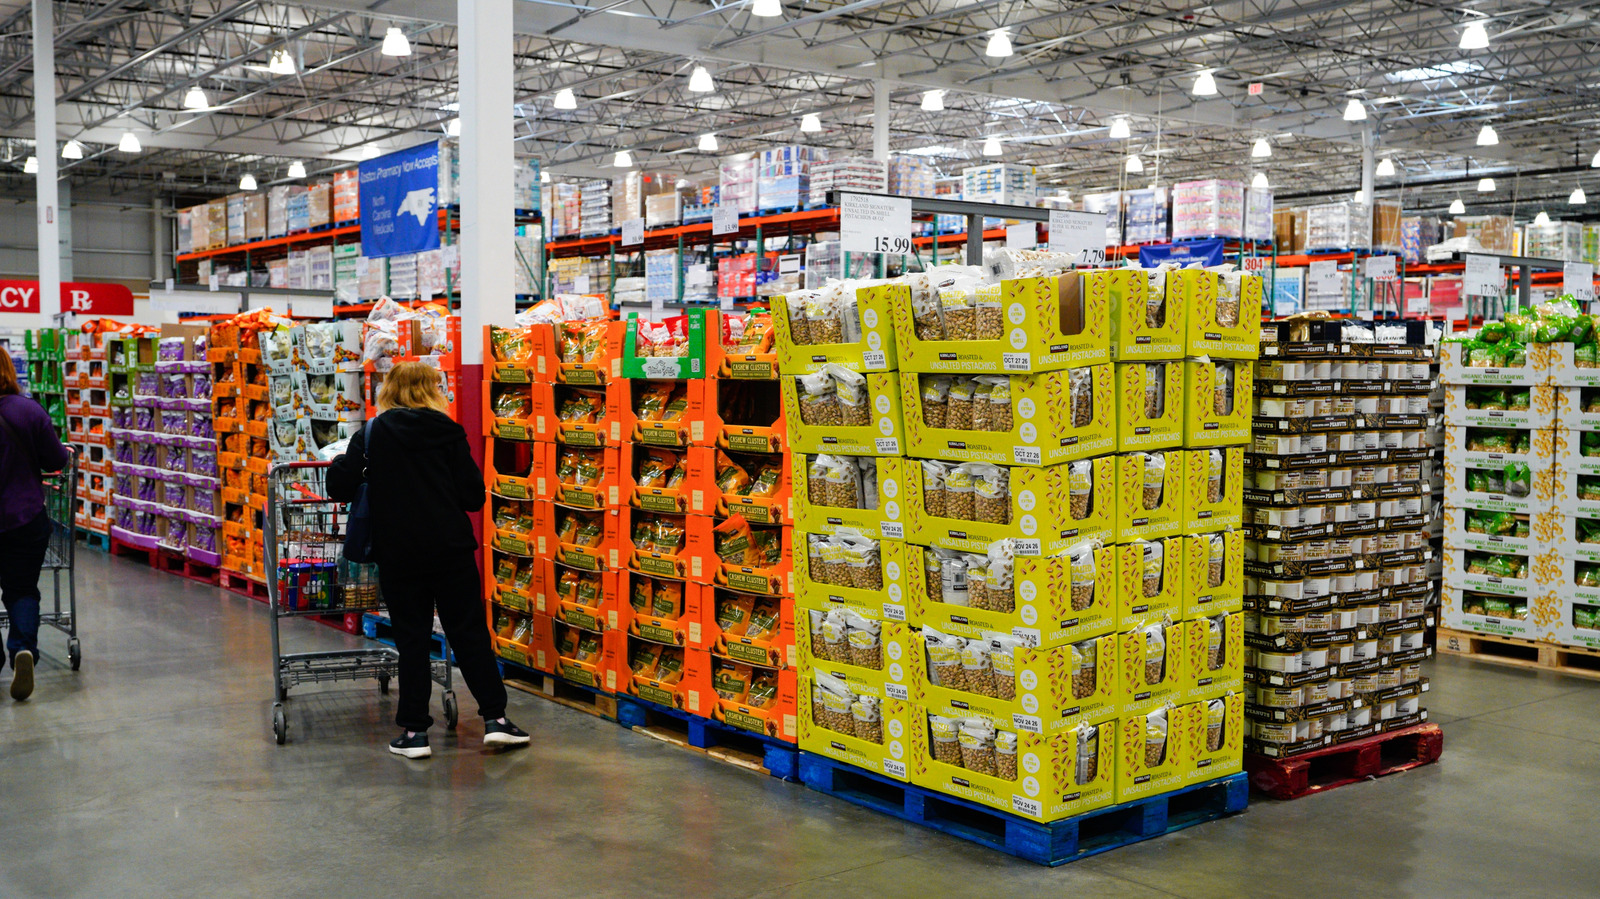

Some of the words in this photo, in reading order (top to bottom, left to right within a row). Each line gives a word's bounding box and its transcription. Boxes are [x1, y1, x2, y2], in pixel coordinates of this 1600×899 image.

[377, 165, 401, 179] Pharmacy
[402, 160, 414, 172] Now
[414, 154, 438, 170] Accepts
[372, 222, 394, 235] Medicaid
[724, 224, 738, 232] 13.99
[874, 236, 910, 253] 15.99
[1082, 249, 1105, 263] 7.79
[1244, 258, 1263, 270] 304
[1480, 284, 1498, 295] 17.79
[1576, 289, 1592, 299] 17.99
[0, 287, 34, 308] CY
[1125, 345, 1151, 354] UNSALTED
[1152, 344, 1181, 353] PISTACHIOS
[1192, 340, 1222, 350] UNSALTED
[1223, 342, 1255, 352] PISTACHIOS
[1038, 353, 1070, 365] UNSALTED
[1071, 349, 1106, 360] PISTACHIOS
[324, 365, 335, 373] MIX
[750, 363, 770, 371] CLUSTERS
[930, 361, 960, 370] UNSALTED
[961, 362, 997, 370] PISTACHIOS
[643, 430, 658, 438] CASHEW
[658, 430, 676, 438] CLUSTERS
[730, 436, 746, 444] CASHEW
[746, 437, 767, 445] CLUSTERS
[1049, 445, 1080, 458] UNSALTED
[1081, 437, 1113, 451] PISTACHIOS
[938, 449, 969, 459] UNSALTED
[970, 451, 1006, 461] PISTACHIOS
[641, 495, 656, 503] CASHEW
[656, 497, 674, 505] CLUSTERS
[729, 504, 746, 512] CASHEW
[746, 505, 767, 515] CLUSTERS
[1121, 526, 1149, 537] UNSALTED
[1150, 521, 1179, 533] PISTACHIOS
[728, 572, 745, 581] CASHEW
[745, 575, 767, 585] CLUSTERS
[1049, 626, 1080, 641] UNSALTED
[1081, 619, 1112, 633] PISTACHIOS
[1484, 621, 1501, 629] WHOLE
[1502, 625, 1526, 633] CASHEWS
[728, 642, 745, 651] CASHEW
[745, 646, 766, 656] CLUSTERS
[725, 710, 742, 721] CASHEW
[743, 716, 763, 727] CLUSTERS
[943, 784, 972, 798] UNSALTED
[974, 792, 1008, 808] PISTACHIOS
[1013, 798, 1023, 806] NOV
